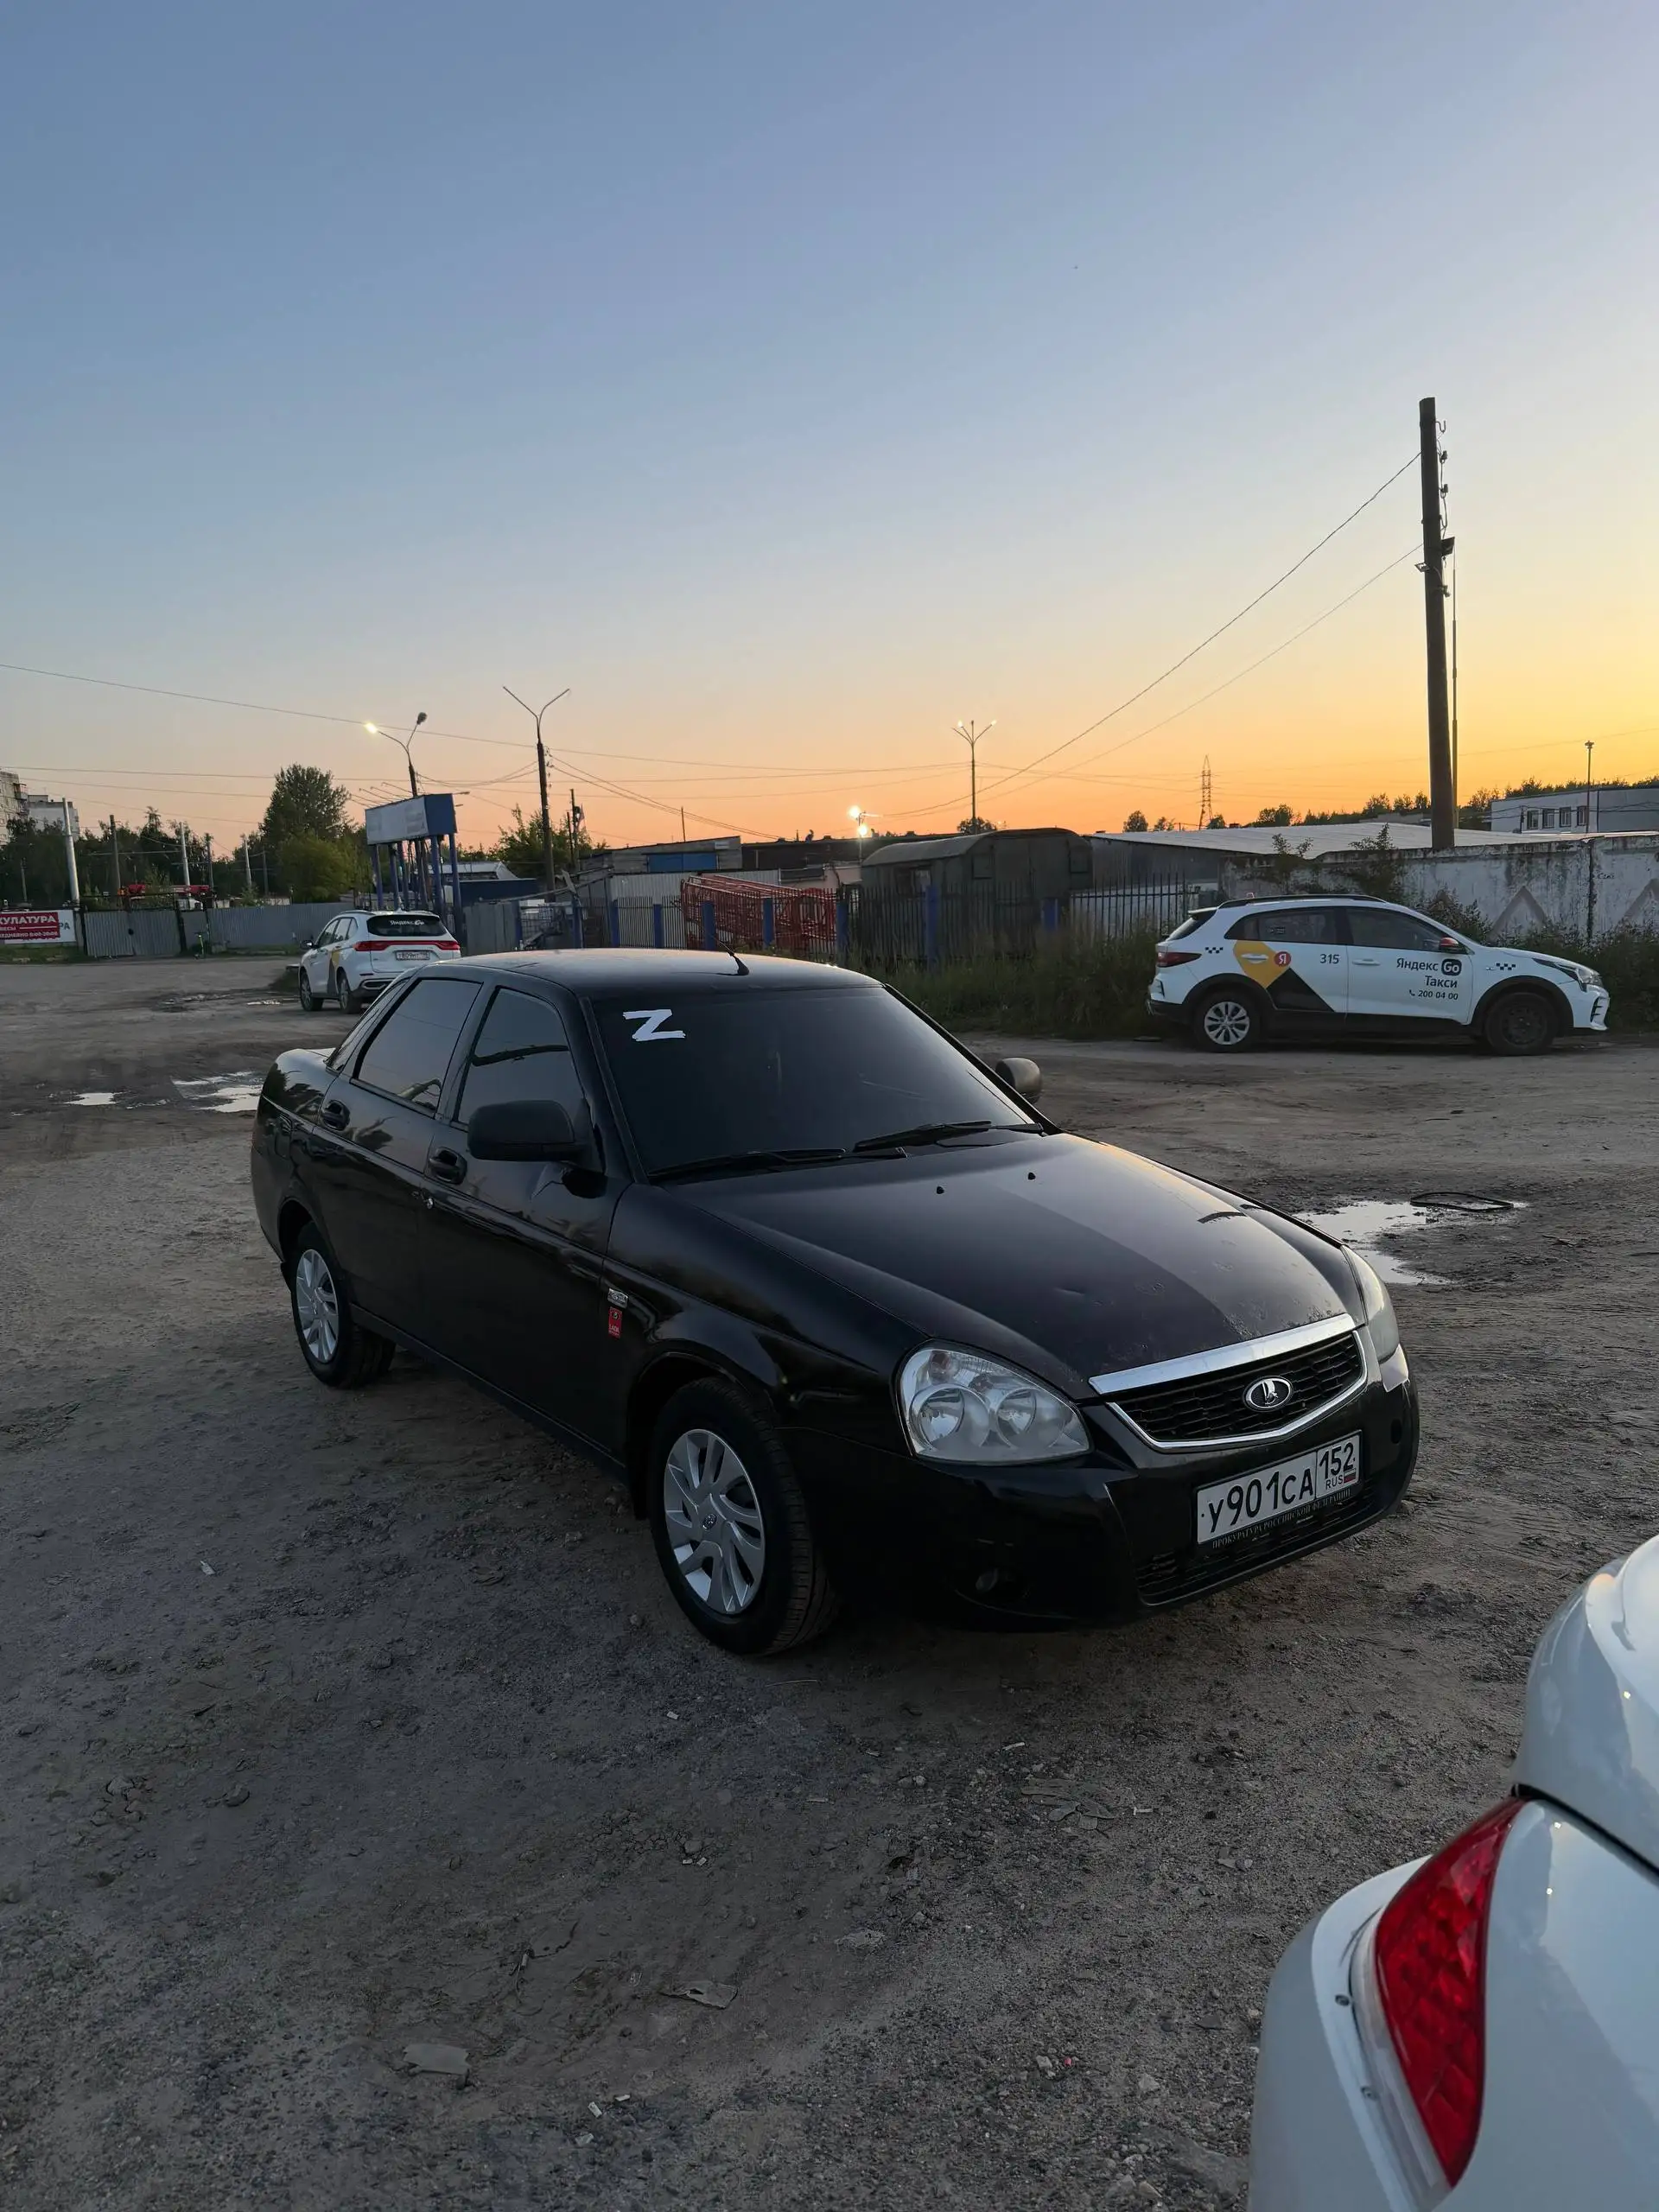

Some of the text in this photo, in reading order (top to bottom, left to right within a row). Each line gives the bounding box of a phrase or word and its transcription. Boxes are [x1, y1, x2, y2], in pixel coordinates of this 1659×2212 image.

[1279, 954, 1287, 964] Я
[1319, 954, 1340, 964] 315
[1396, 957, 1459, 973] Яндекс Go
[1425, 976, 1458, 988] Такси
[622, 1008, 686, 1041] Z
[1208, 1442, 1354, 1533] У901СА 152
[1325, 1474, 1344, 1490] RUS
[1212, 1487, 1351, 1549] ПРОКУРАТУРА РОССИЙСКОЙ ФЕДЕРАЦИИ
